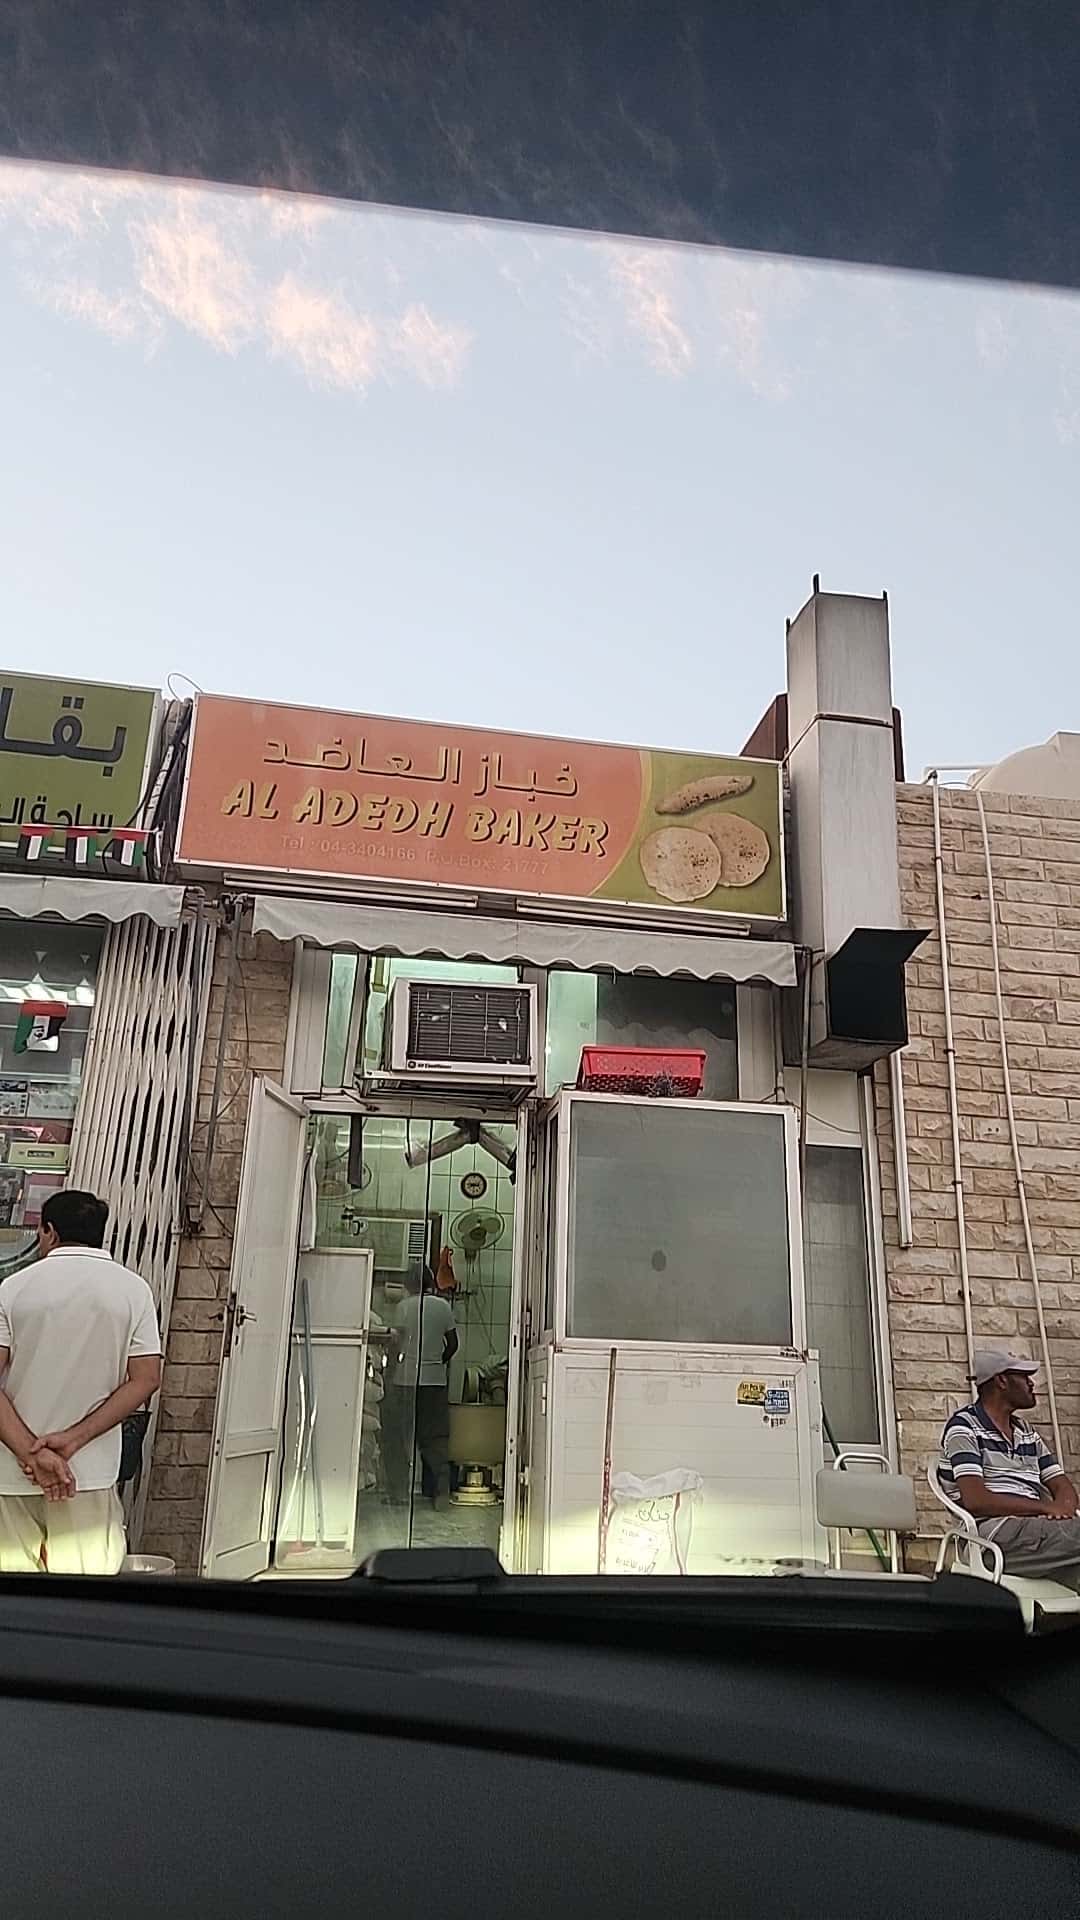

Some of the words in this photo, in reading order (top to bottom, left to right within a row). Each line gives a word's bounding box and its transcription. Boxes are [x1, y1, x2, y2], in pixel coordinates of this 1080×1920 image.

[262, 736, 462, 785] العاضد
[474, 752, 579, 802] خباز
[220, 779, 279, 820] AL
[292, 786, 454, 838] ADEDH
[465, 805, 610, 858] BAKER
[281, 835, 304, 849] Tel
